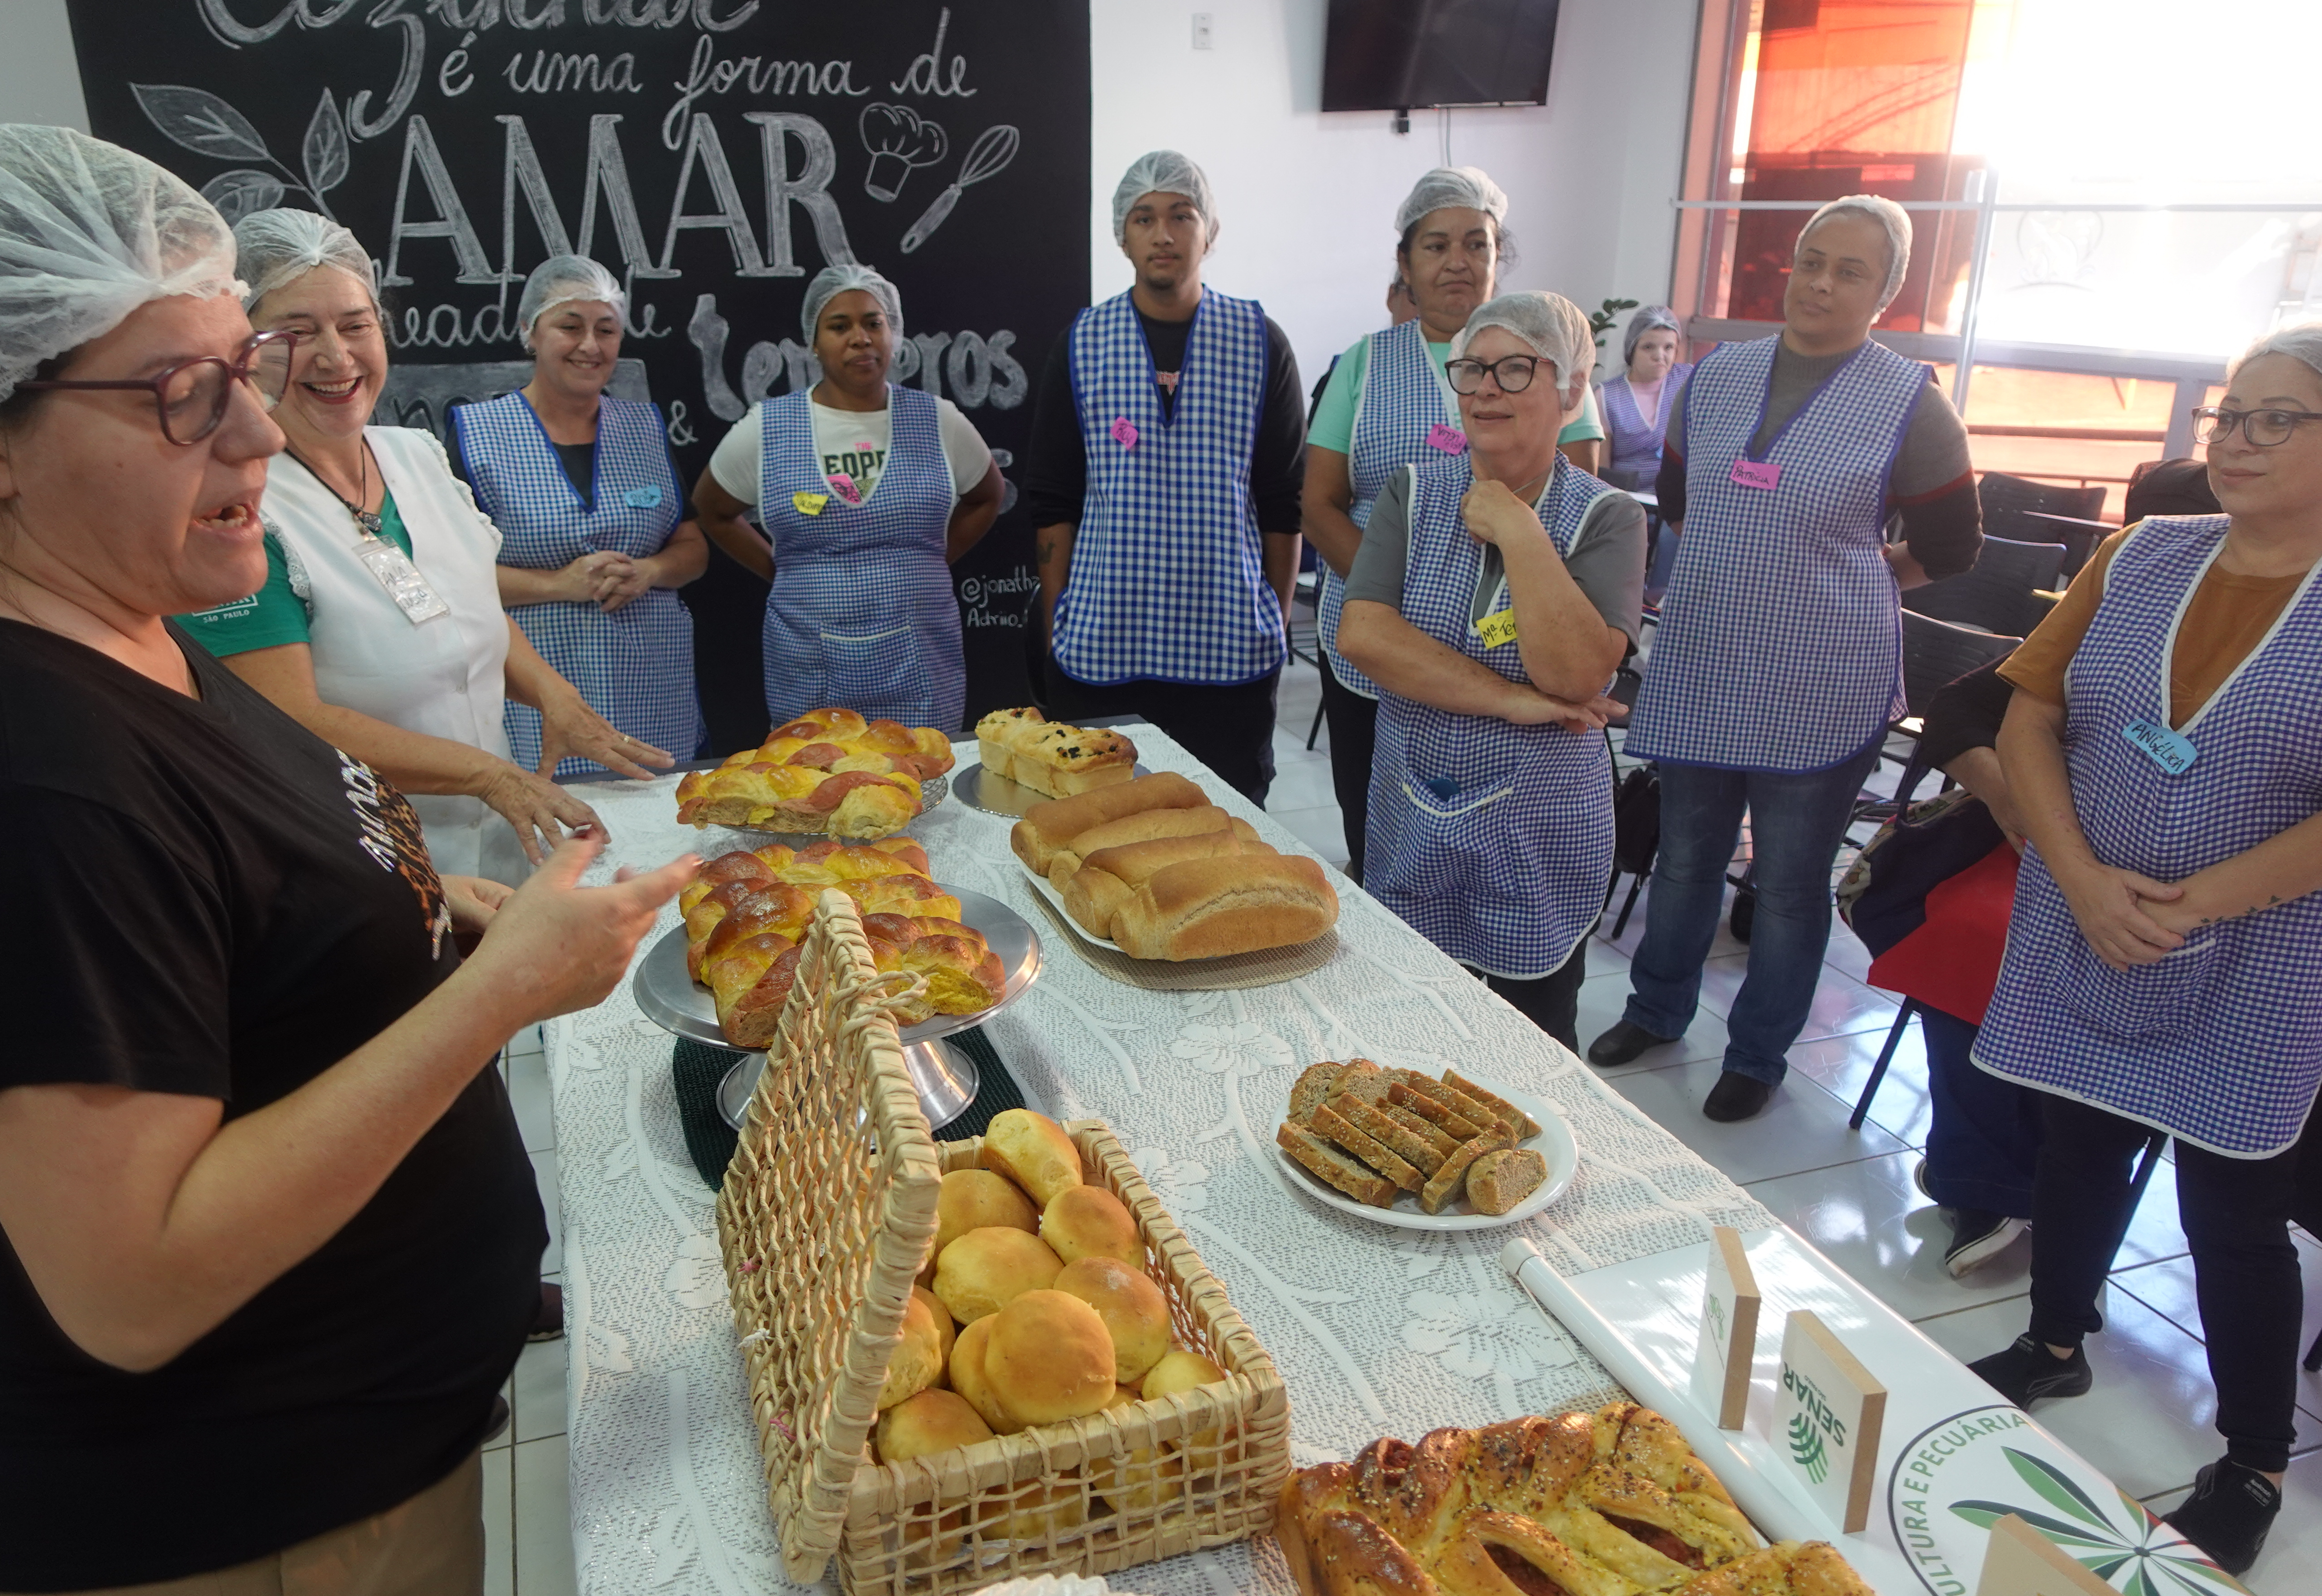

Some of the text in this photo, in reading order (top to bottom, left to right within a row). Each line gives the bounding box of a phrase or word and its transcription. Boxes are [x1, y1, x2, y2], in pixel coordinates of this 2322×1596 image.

[439, 6, 977, 150] é uma forma de
[383, 111, 875, 286] AMAR
[667, 399, 698, 445] &
[854, 441, 873, 451] THE
[203, 609, 251, 624] SÃO PAULO
[1783, 1361, 1847, 1447] SENAR
[1910, 1412, 2029, 1477] PECUÁRIA
[1903, 1477, 1929, 1494] E
